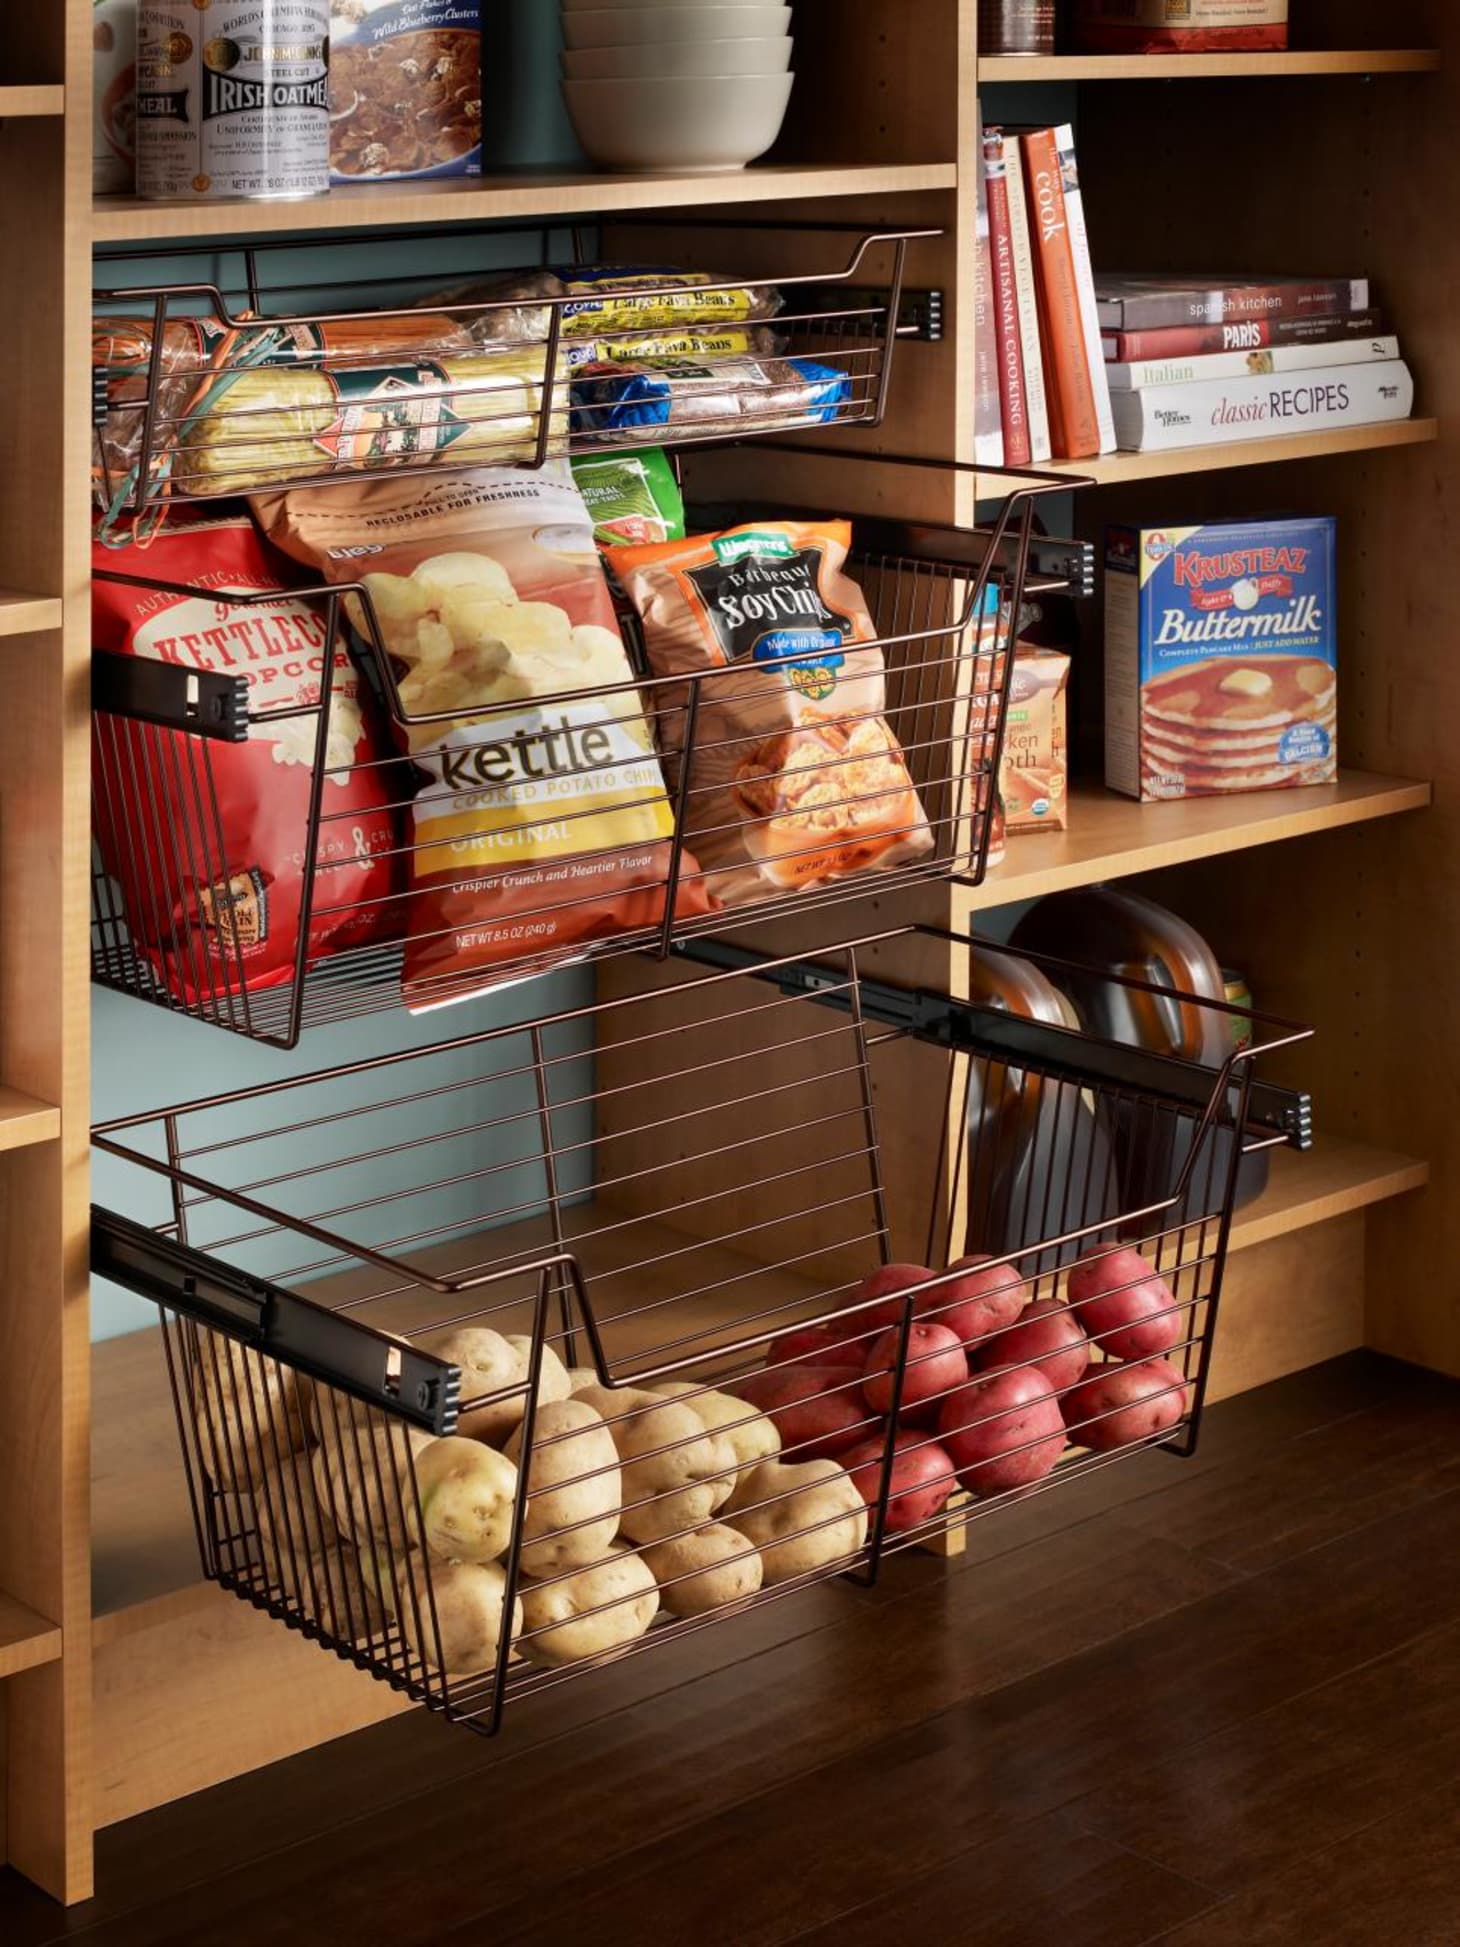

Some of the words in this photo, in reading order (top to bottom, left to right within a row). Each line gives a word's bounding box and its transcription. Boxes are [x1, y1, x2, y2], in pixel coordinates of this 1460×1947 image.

[371, 20, 398, 40] Wild
[398, 13, 445, 32] Blueberry
[445, 8, 479, 20] Clusters
[208, 74, 268, 115] IRISH
[1036, 171, 1065, 244] cook
[694, 291, 736, 307] Beans
[997, 233, 1016, 335] ARTISANAL
[1239, 295, 1283, 311] kitchen
[690, 336, 733, 351] Beans
[1223, 321, 1261, 349] PARIS
[1005, 338, 1022, 425] COOKING
[1143, 363, 1194, 384] Italian
[1210, 395, 1268, 426] classic
[1269, 383, 1350, 418] RECIPES
[366, 505, 446, 528] RECLOSABLE
[447, 498, 473, 510] FOR
[476, 488, 541, 506] FRESHNESS
[582, 485, 621, 498] ATURAL
[1173, 546, 1311, 588] KRUSTEAZ
[1153, 594, 1322, 646] Buttermilk
[791, 636, 809, 649] with
[439, 715, 614, 790] kettle
[452, 786, 538, 811] COOKED
[545, 772, 617, 795] POTATO
[449, 822, 573, 853] ORIGINAL
[452, 879, 498, 895] Crispier
[502, 871, 544, 889] Crunch
[545, 867, 568, 881] and
[571, 862, 616, 879] Heartier
[618, 854, 653, 870] Flavor
[456, 933, 477, 948] NET
[478, 930, 493, 945] WT
[494, 928, 509, 942] 8.5
[510, 926, 525, 941] OZ
